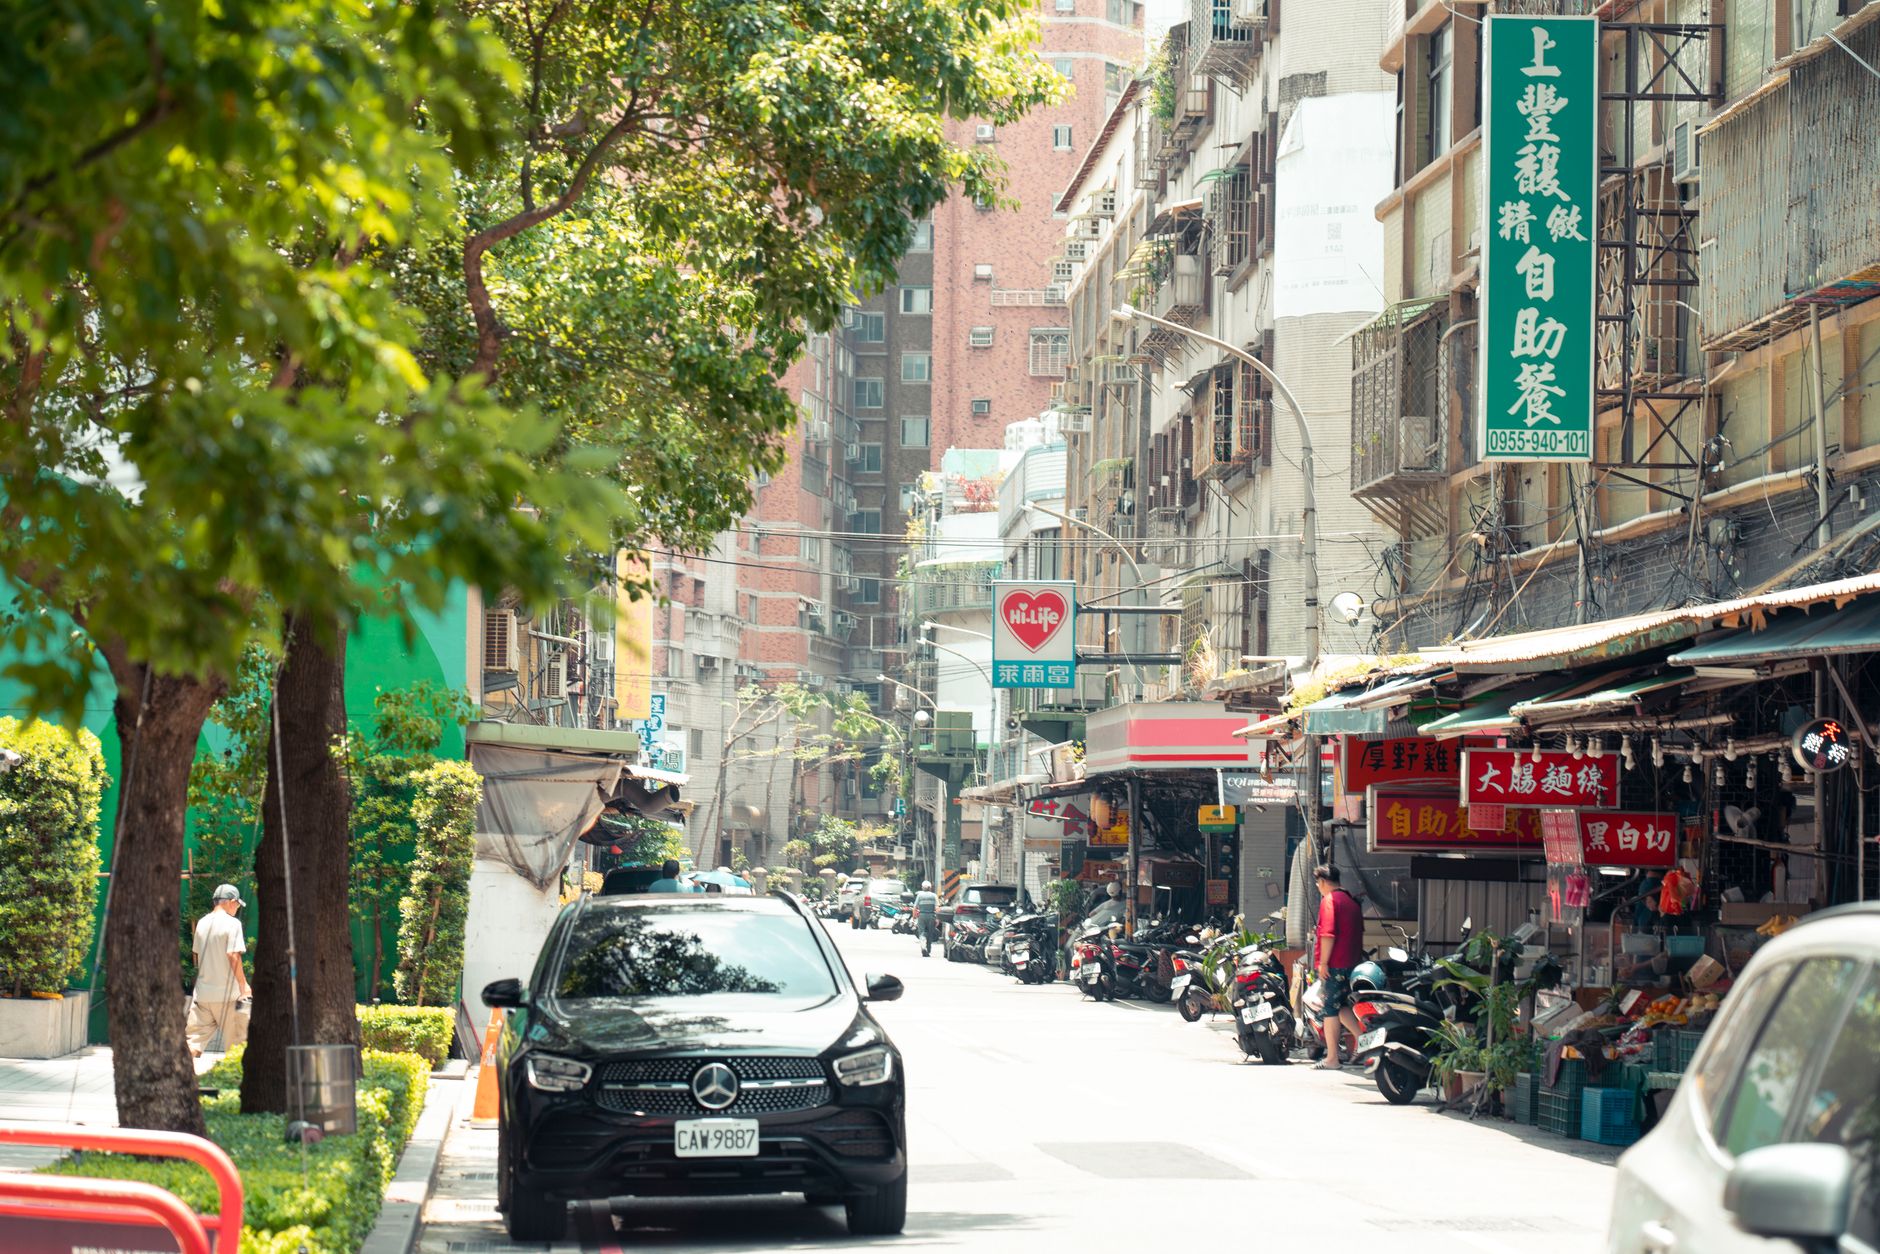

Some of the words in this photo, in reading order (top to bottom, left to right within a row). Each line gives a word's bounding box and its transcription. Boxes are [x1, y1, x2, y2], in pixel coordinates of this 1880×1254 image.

[1490, 431, 1585, 452] 0955-940-101
[998, 664, 1070, 684] 萊爾富
[1359, 740, 1478, 773] 厚野雞
[1475, 761, 1609, 797] 大腸麵線
[1585, 820, 1673, 853] 黑白切
